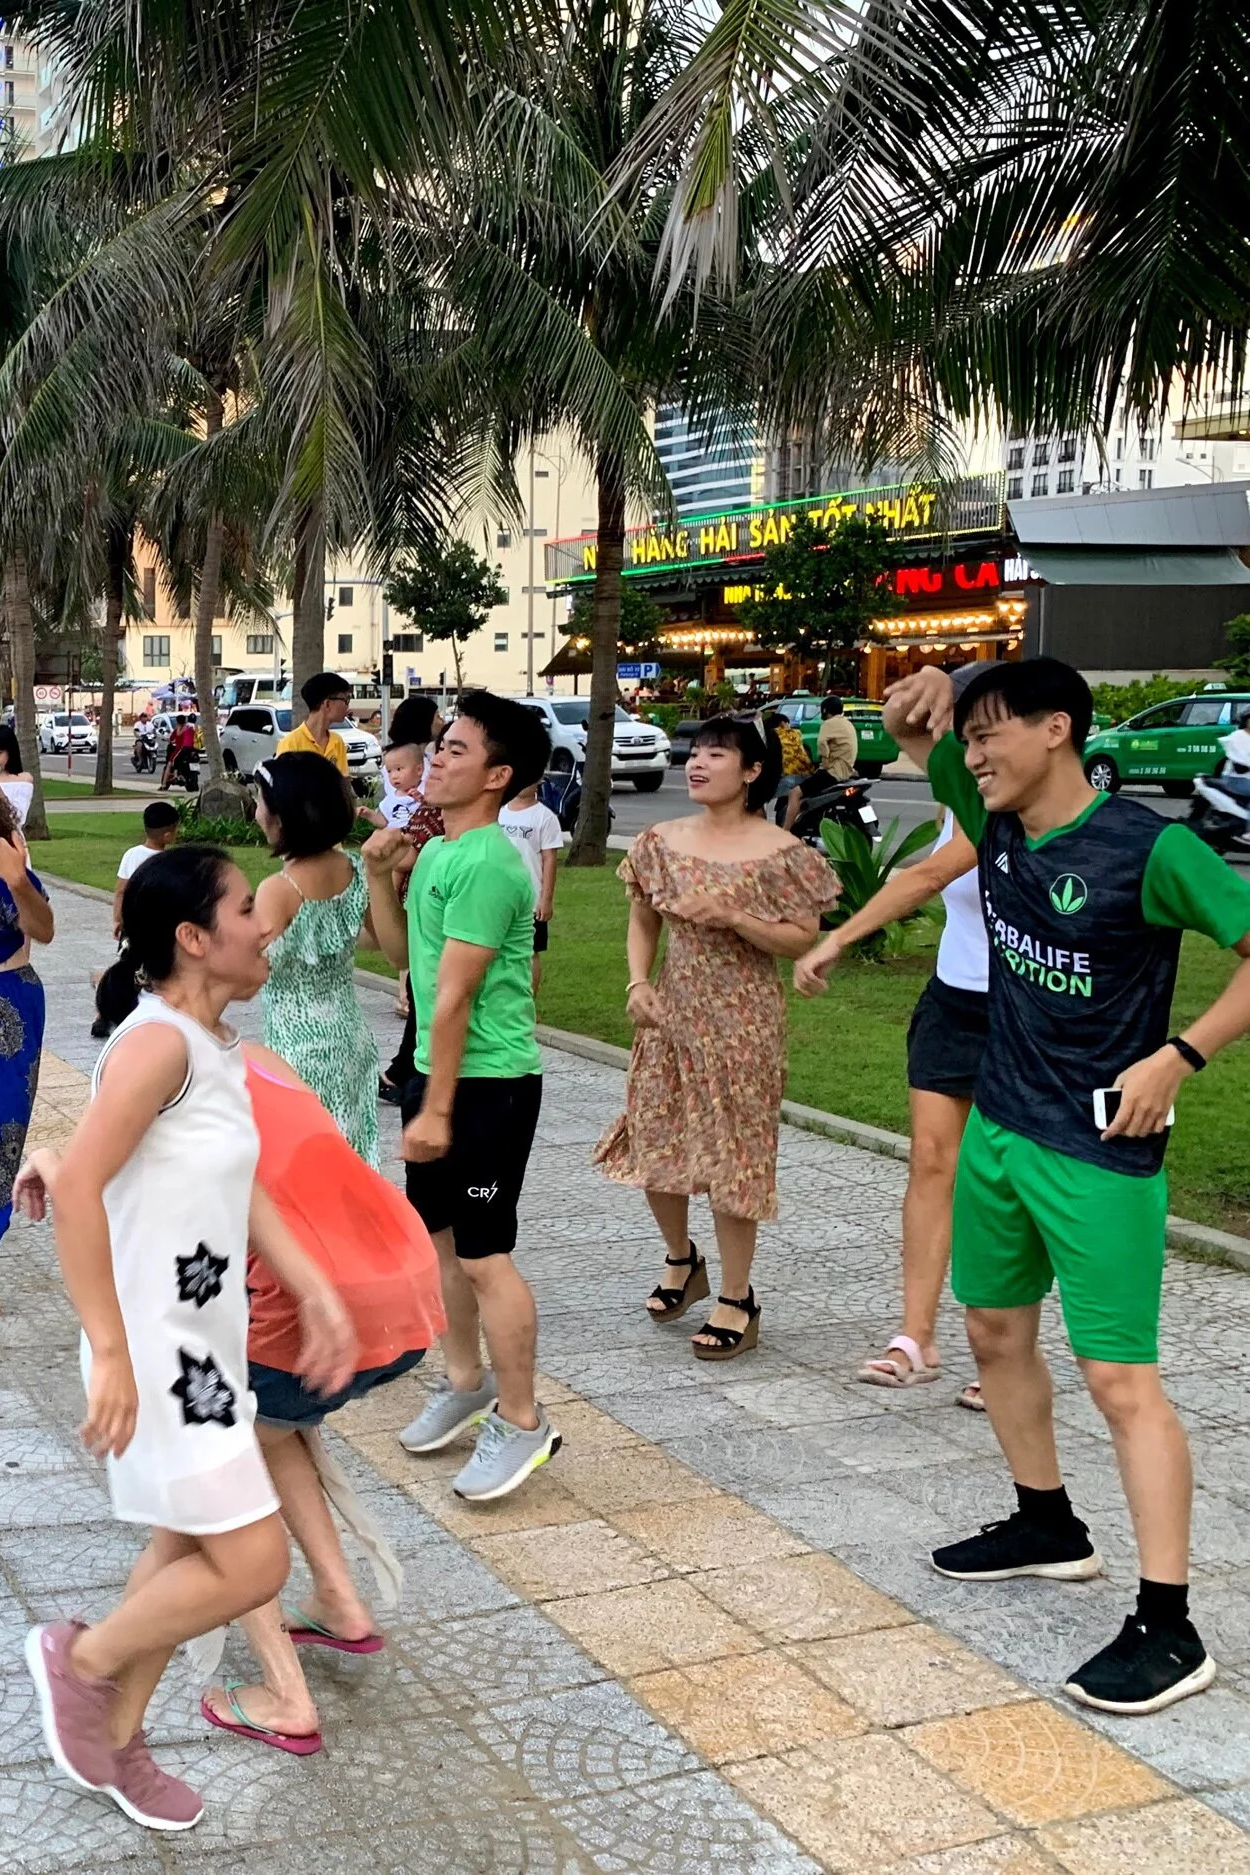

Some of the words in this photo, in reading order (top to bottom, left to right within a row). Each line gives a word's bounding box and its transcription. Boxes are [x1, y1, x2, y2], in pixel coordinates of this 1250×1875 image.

[700, 517, 738, 555] HẢI
[750, 508, 797, 548] SẢN
[644, 664, 653, 677] P
[985, 890, 1091, 973] RBALIFE
